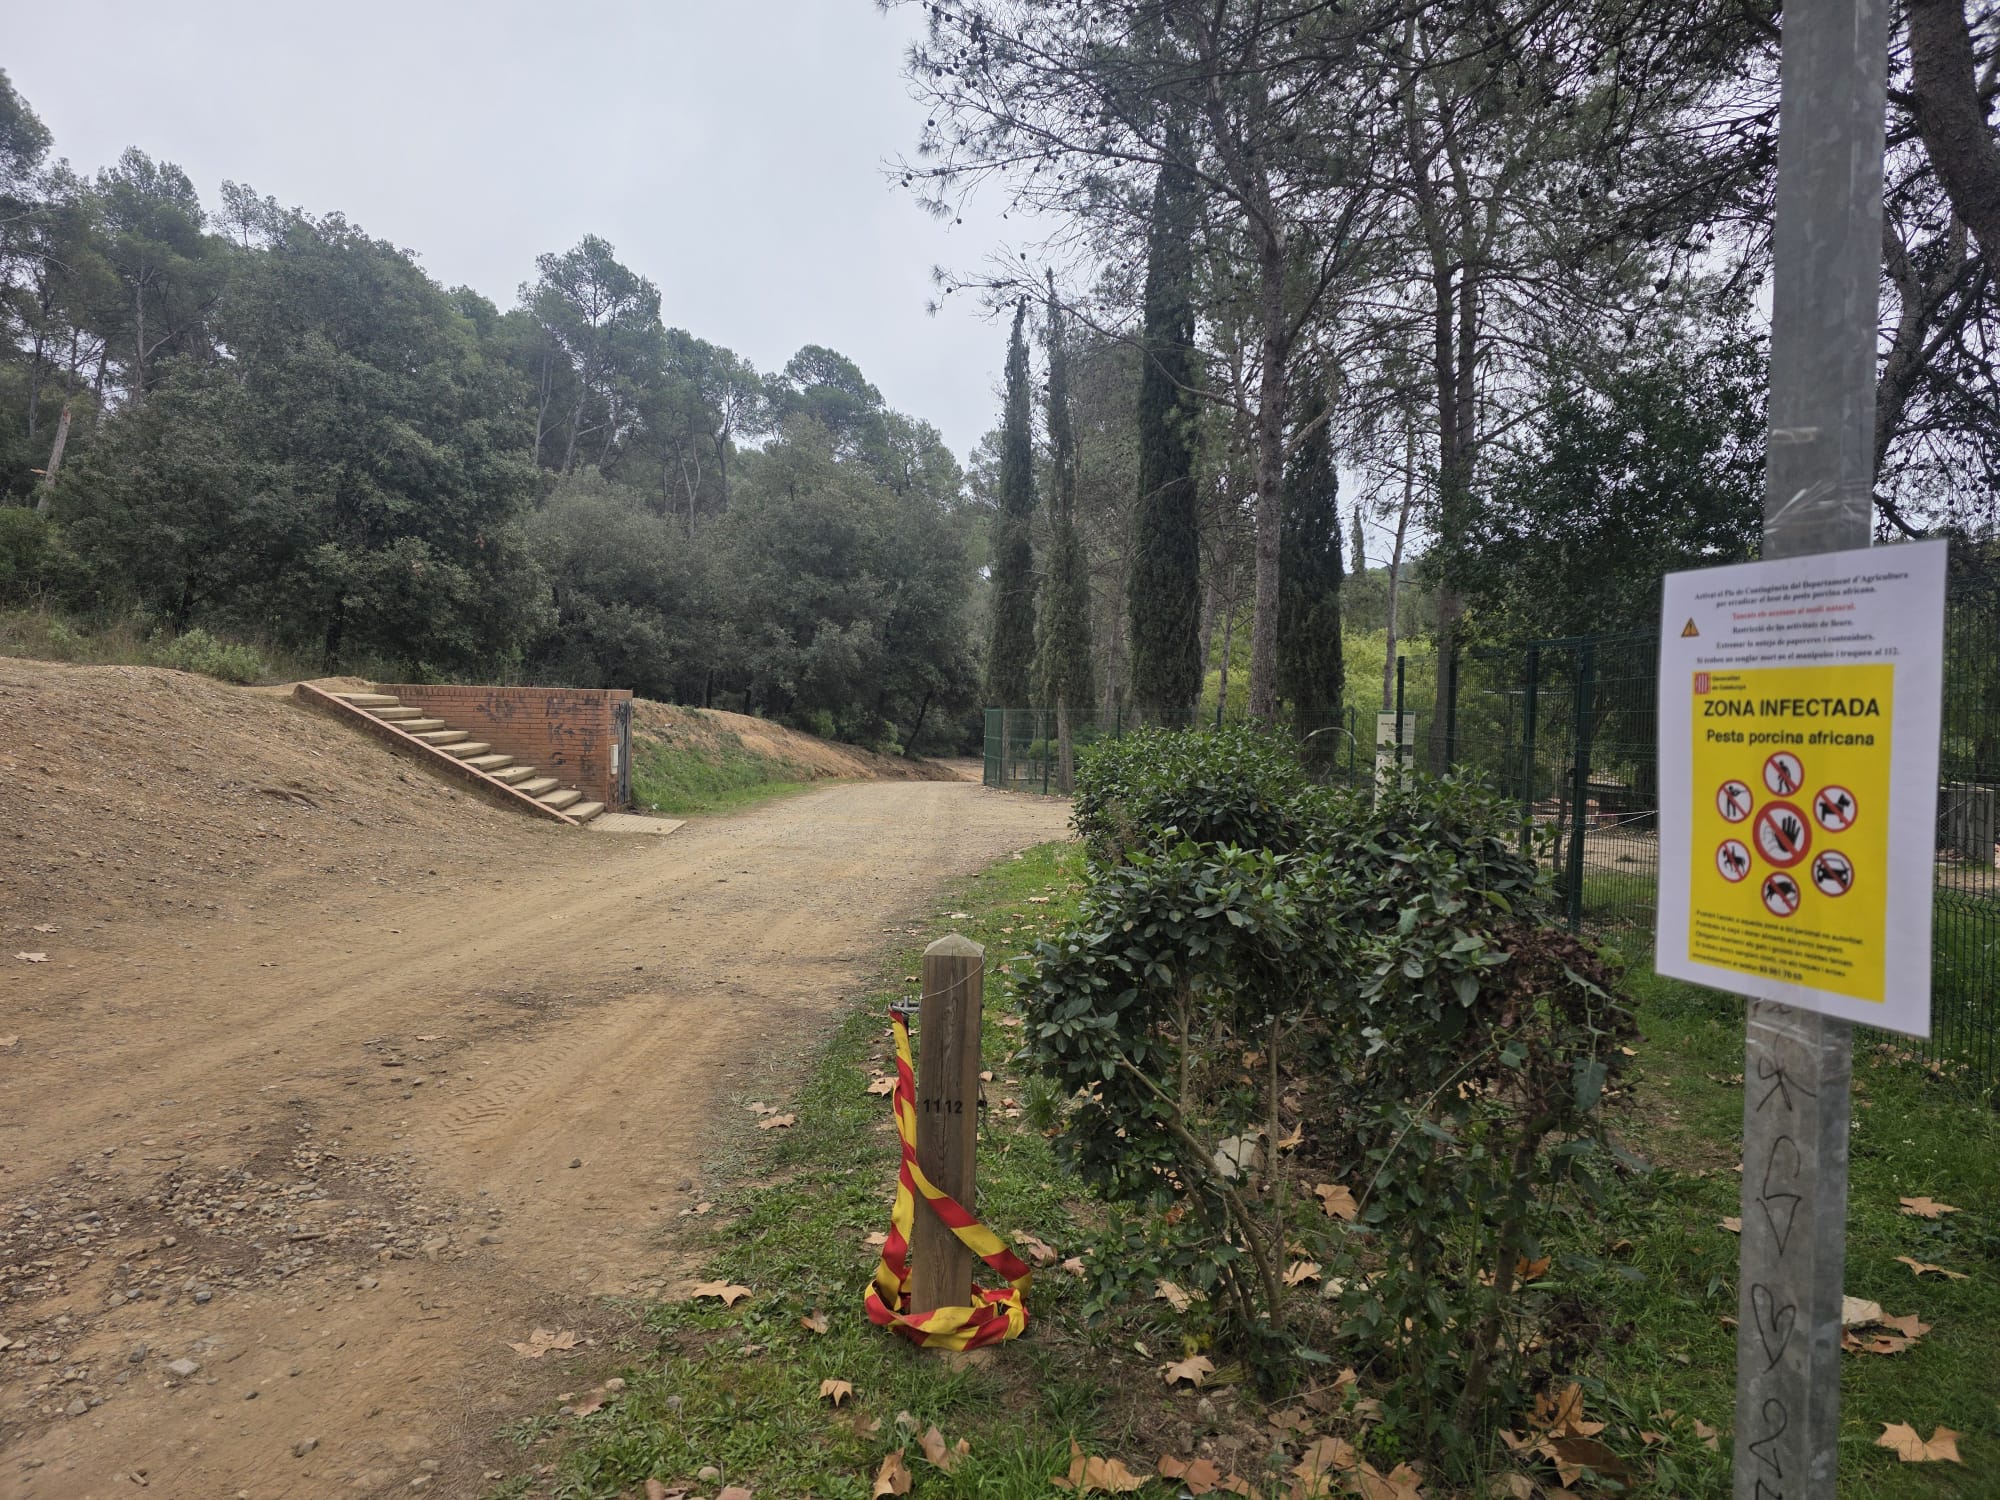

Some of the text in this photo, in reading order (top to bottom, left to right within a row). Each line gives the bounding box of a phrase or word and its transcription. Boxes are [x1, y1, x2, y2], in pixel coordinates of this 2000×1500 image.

[1803, 578, 1850, 589] Departament
[1813, 590, 1840, 599] porcina
[1704, 698, 1880, 717] ZONA INFECTADA
[1707, 729, 1874, 747] Pesta porcina africana
[923, 1098, 963, 1115] 1112
